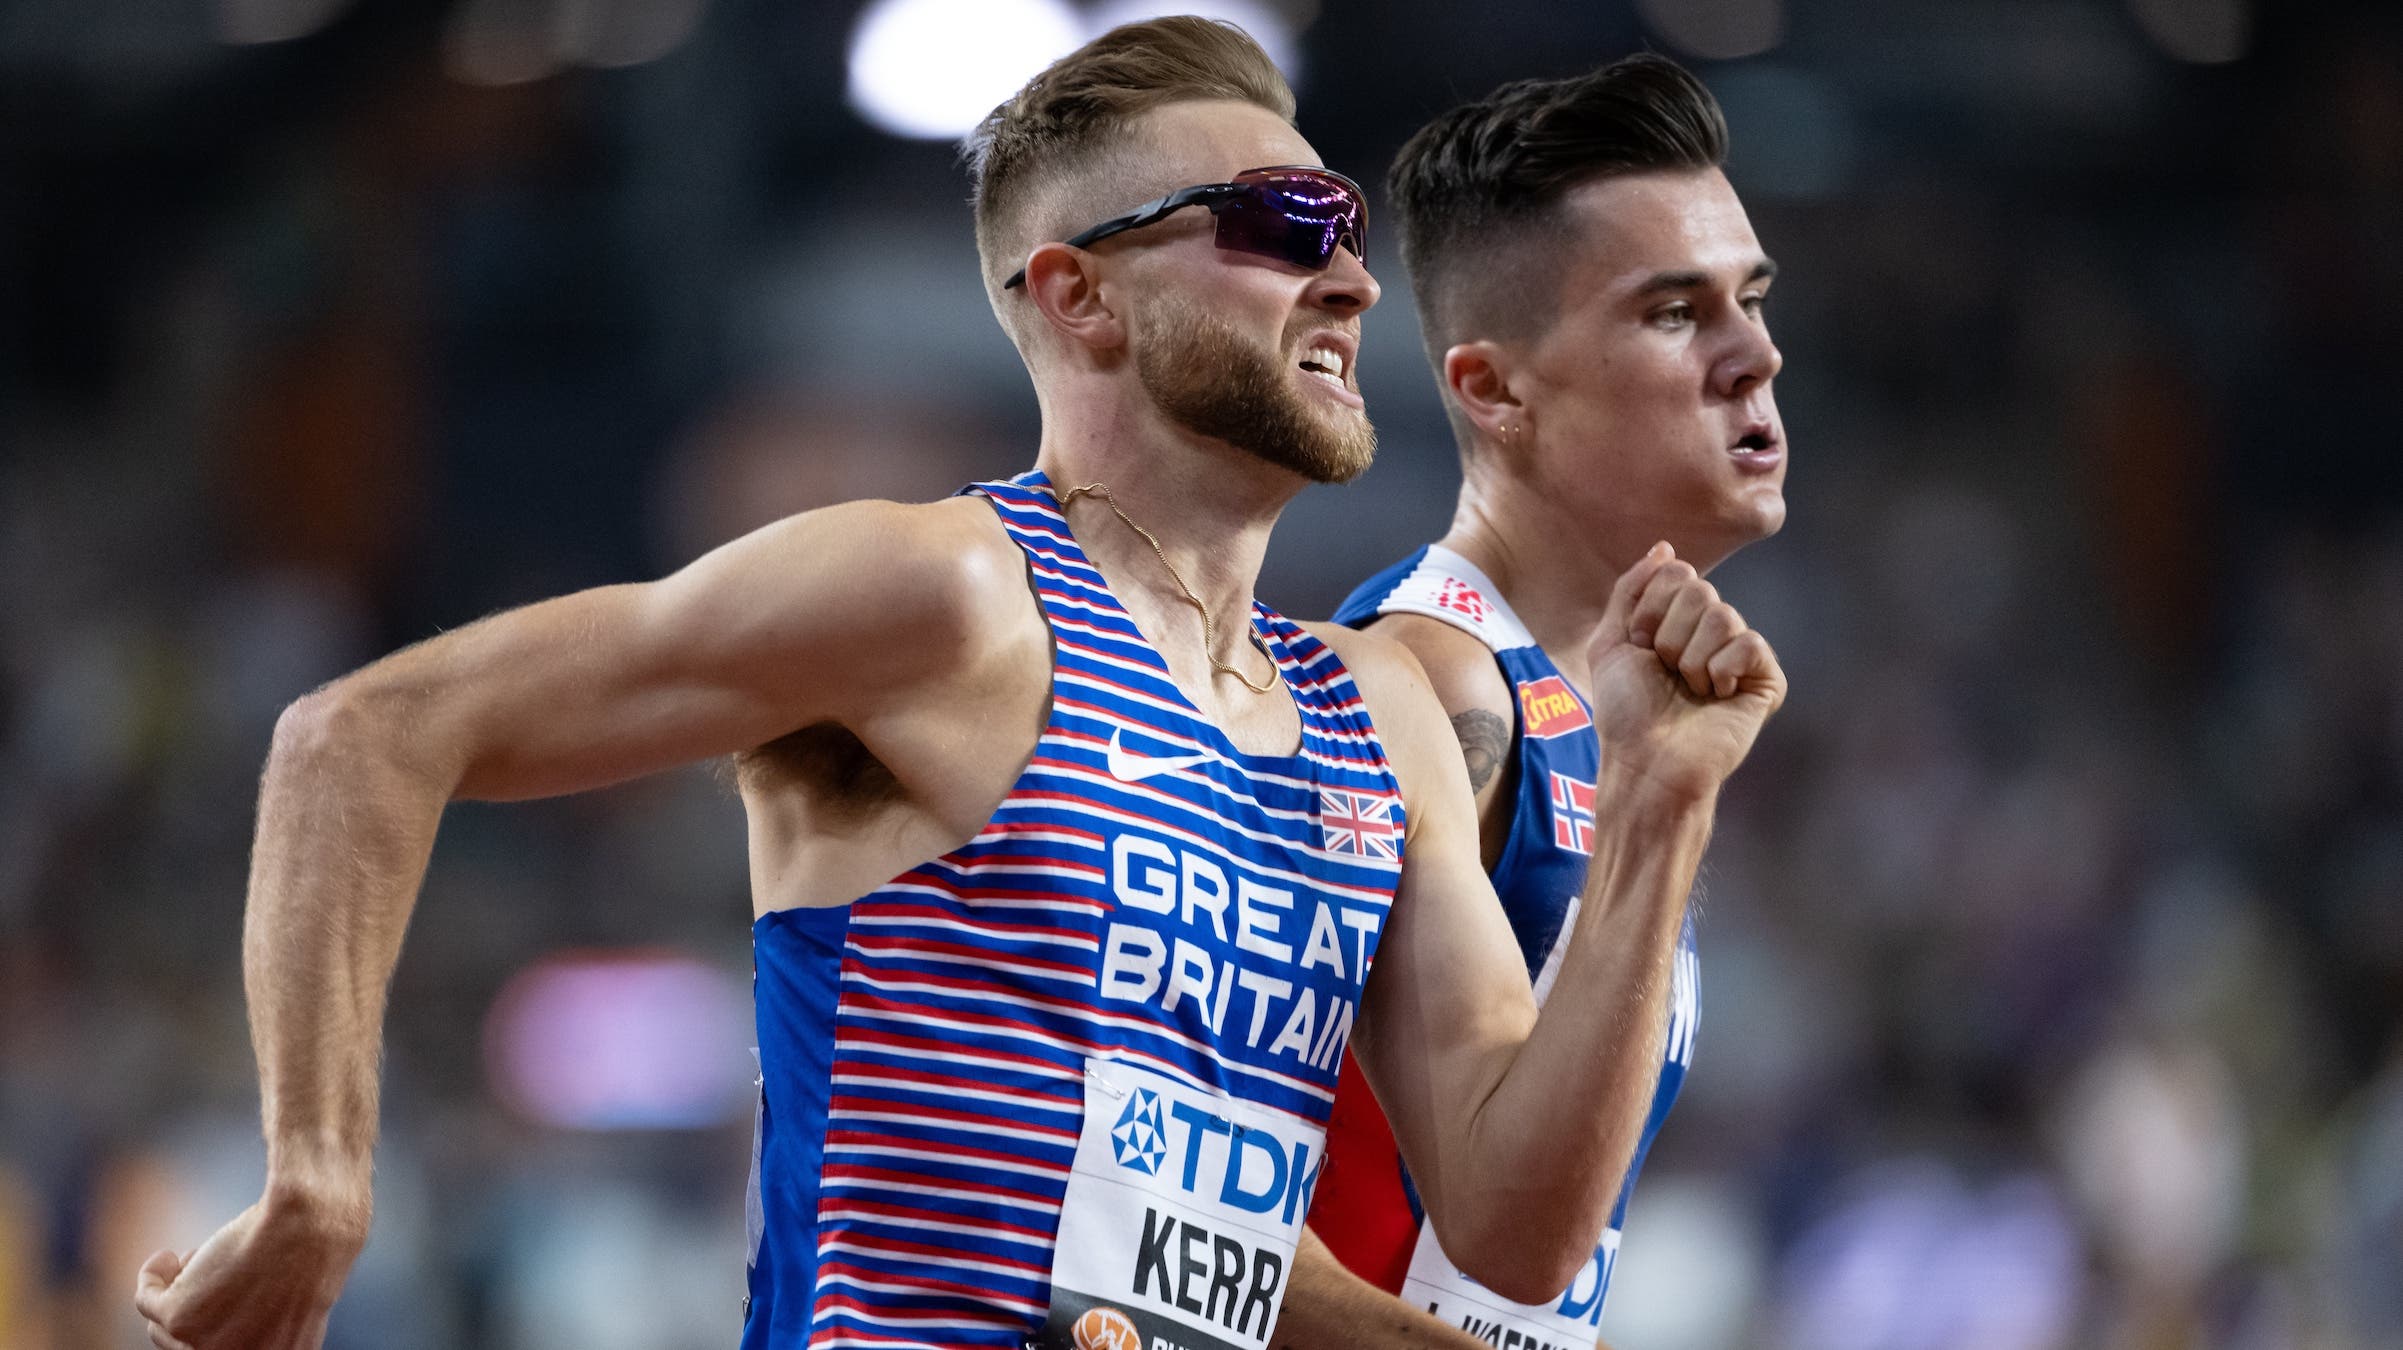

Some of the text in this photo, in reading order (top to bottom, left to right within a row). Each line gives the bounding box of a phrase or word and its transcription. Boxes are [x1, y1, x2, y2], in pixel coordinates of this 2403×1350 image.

[1112, 833, 1380, 985] GREAT
[1100, 922, 1353, 1077] BRITAIN
[1171, 1099, 1323, 1232] TDK
[1132, 1207, 1282, 1342] KERR
